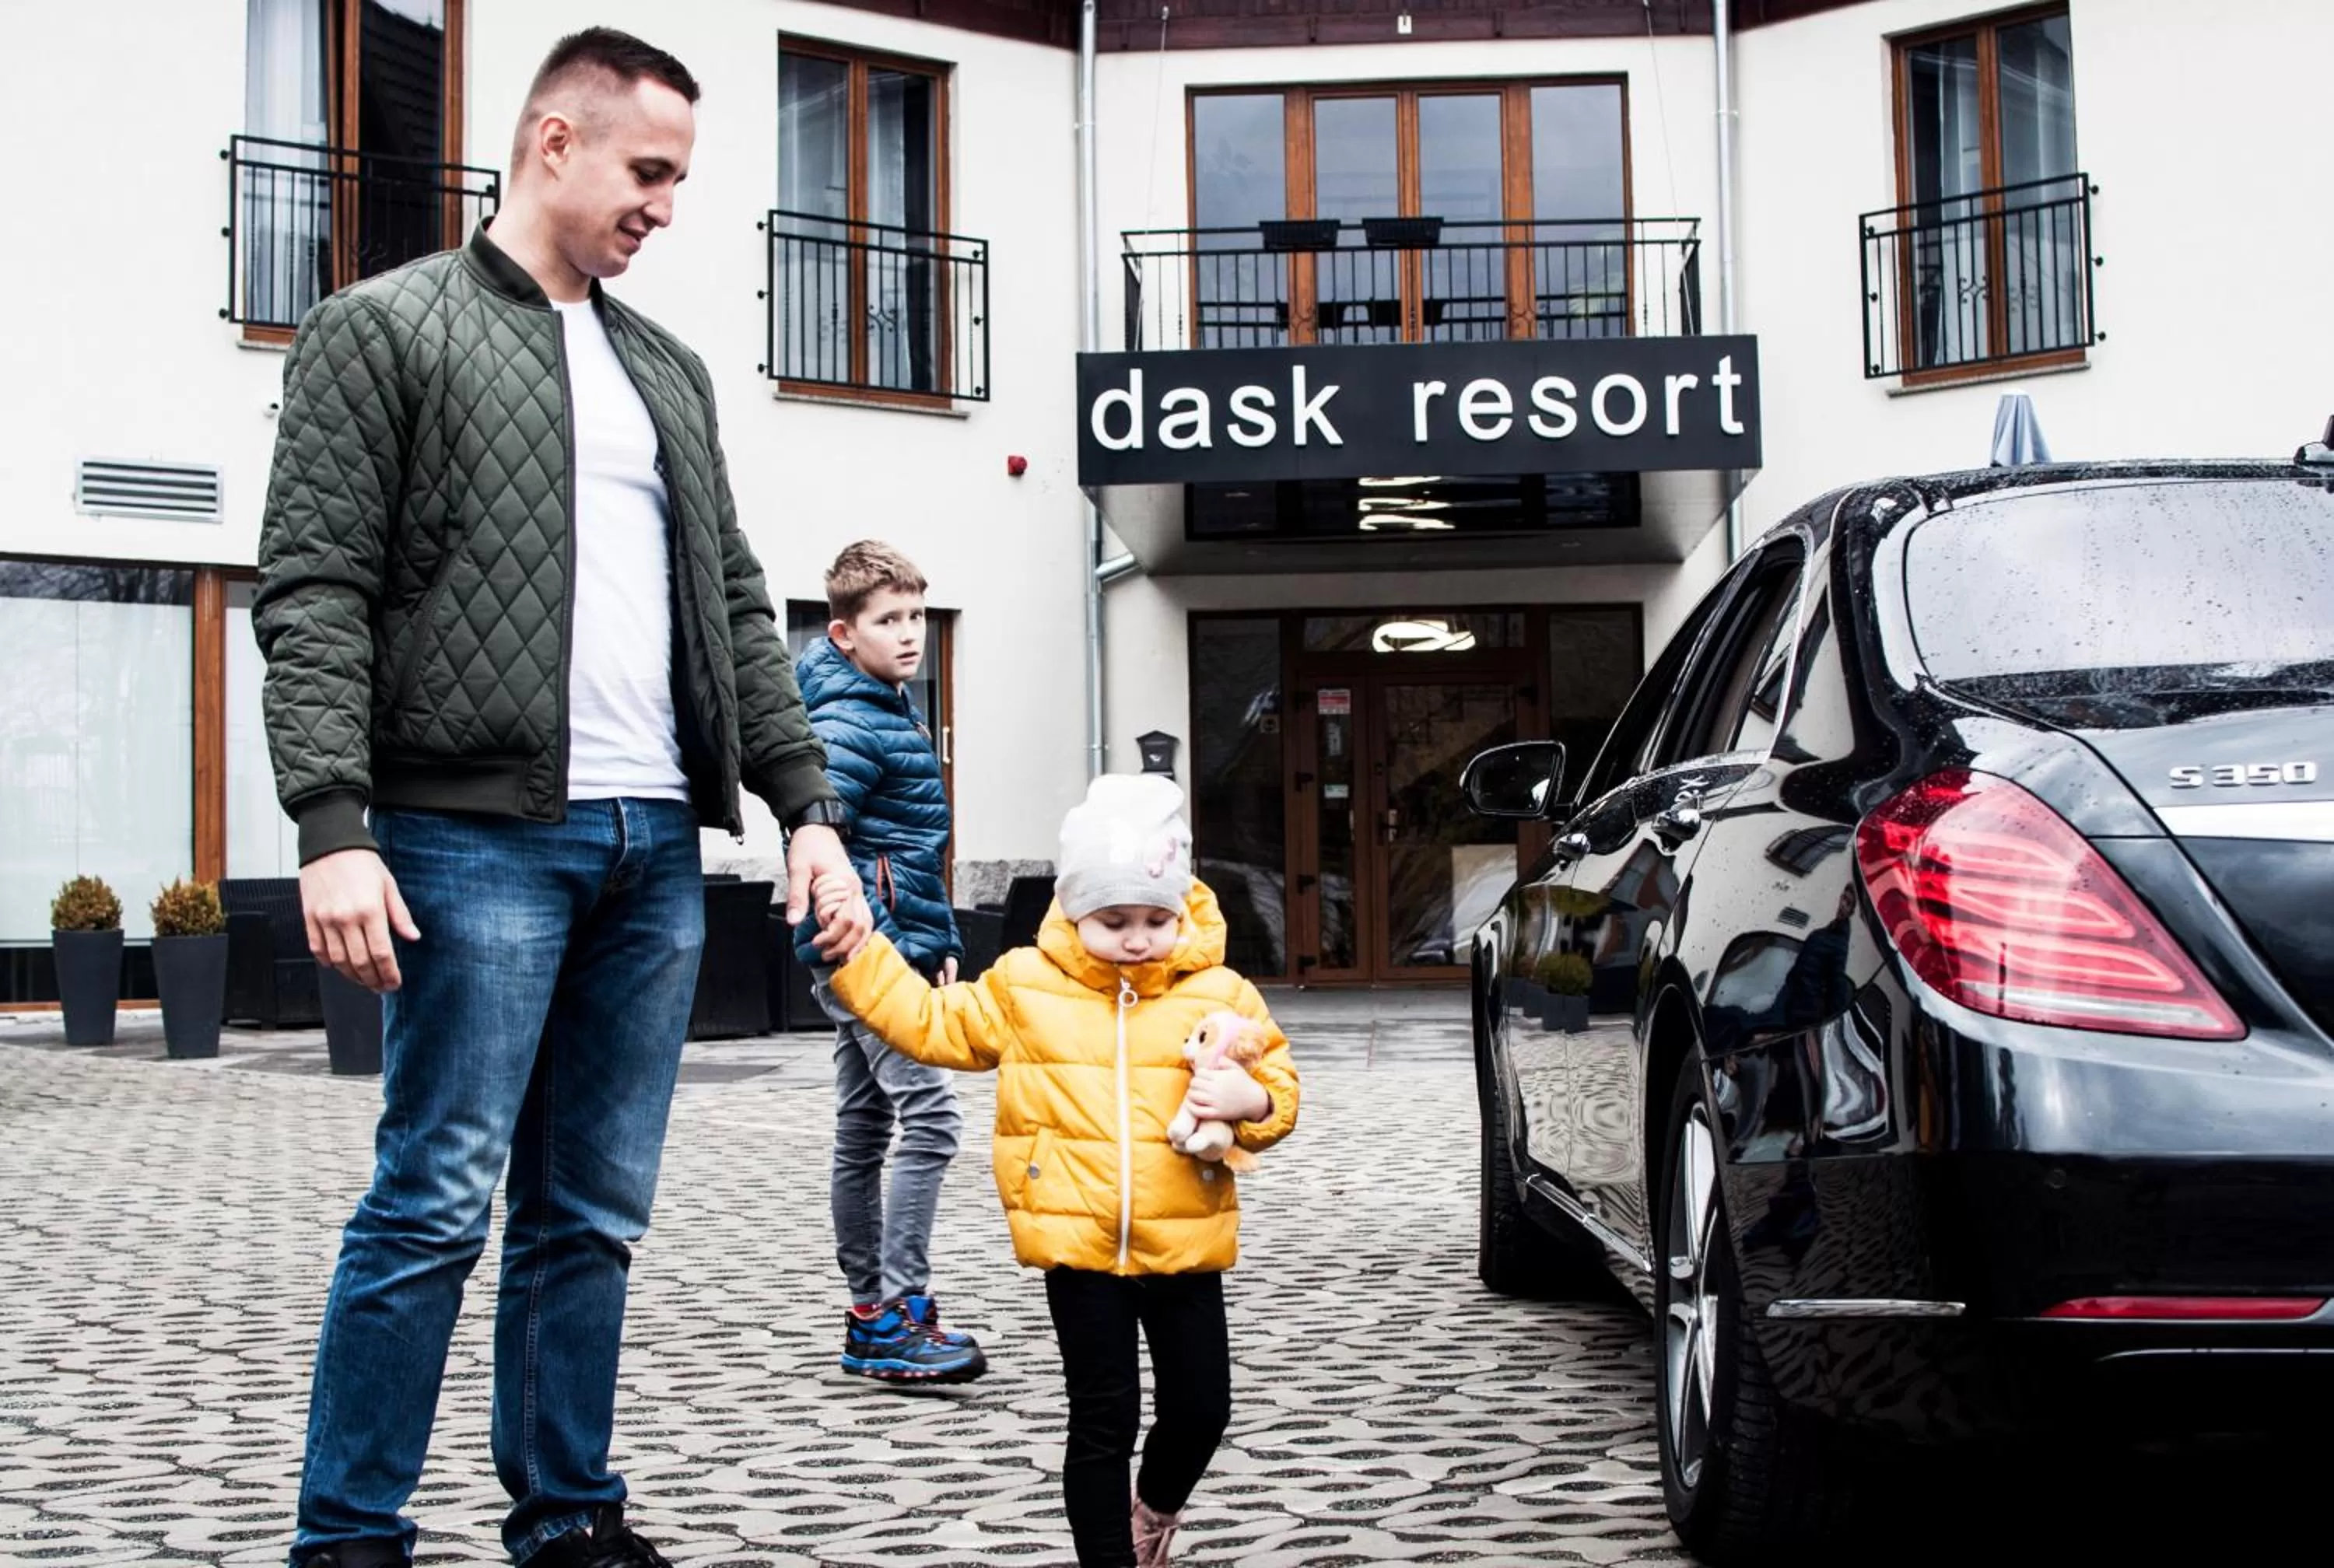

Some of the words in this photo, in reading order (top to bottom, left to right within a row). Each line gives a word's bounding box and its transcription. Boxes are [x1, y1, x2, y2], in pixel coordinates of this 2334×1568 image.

[1091, 366, 1344, 450] dask
[1412, 355, 1744, 443] resort
[2169, 766, 2204, 789] S
[2211, 761, 2317, 787] 350
